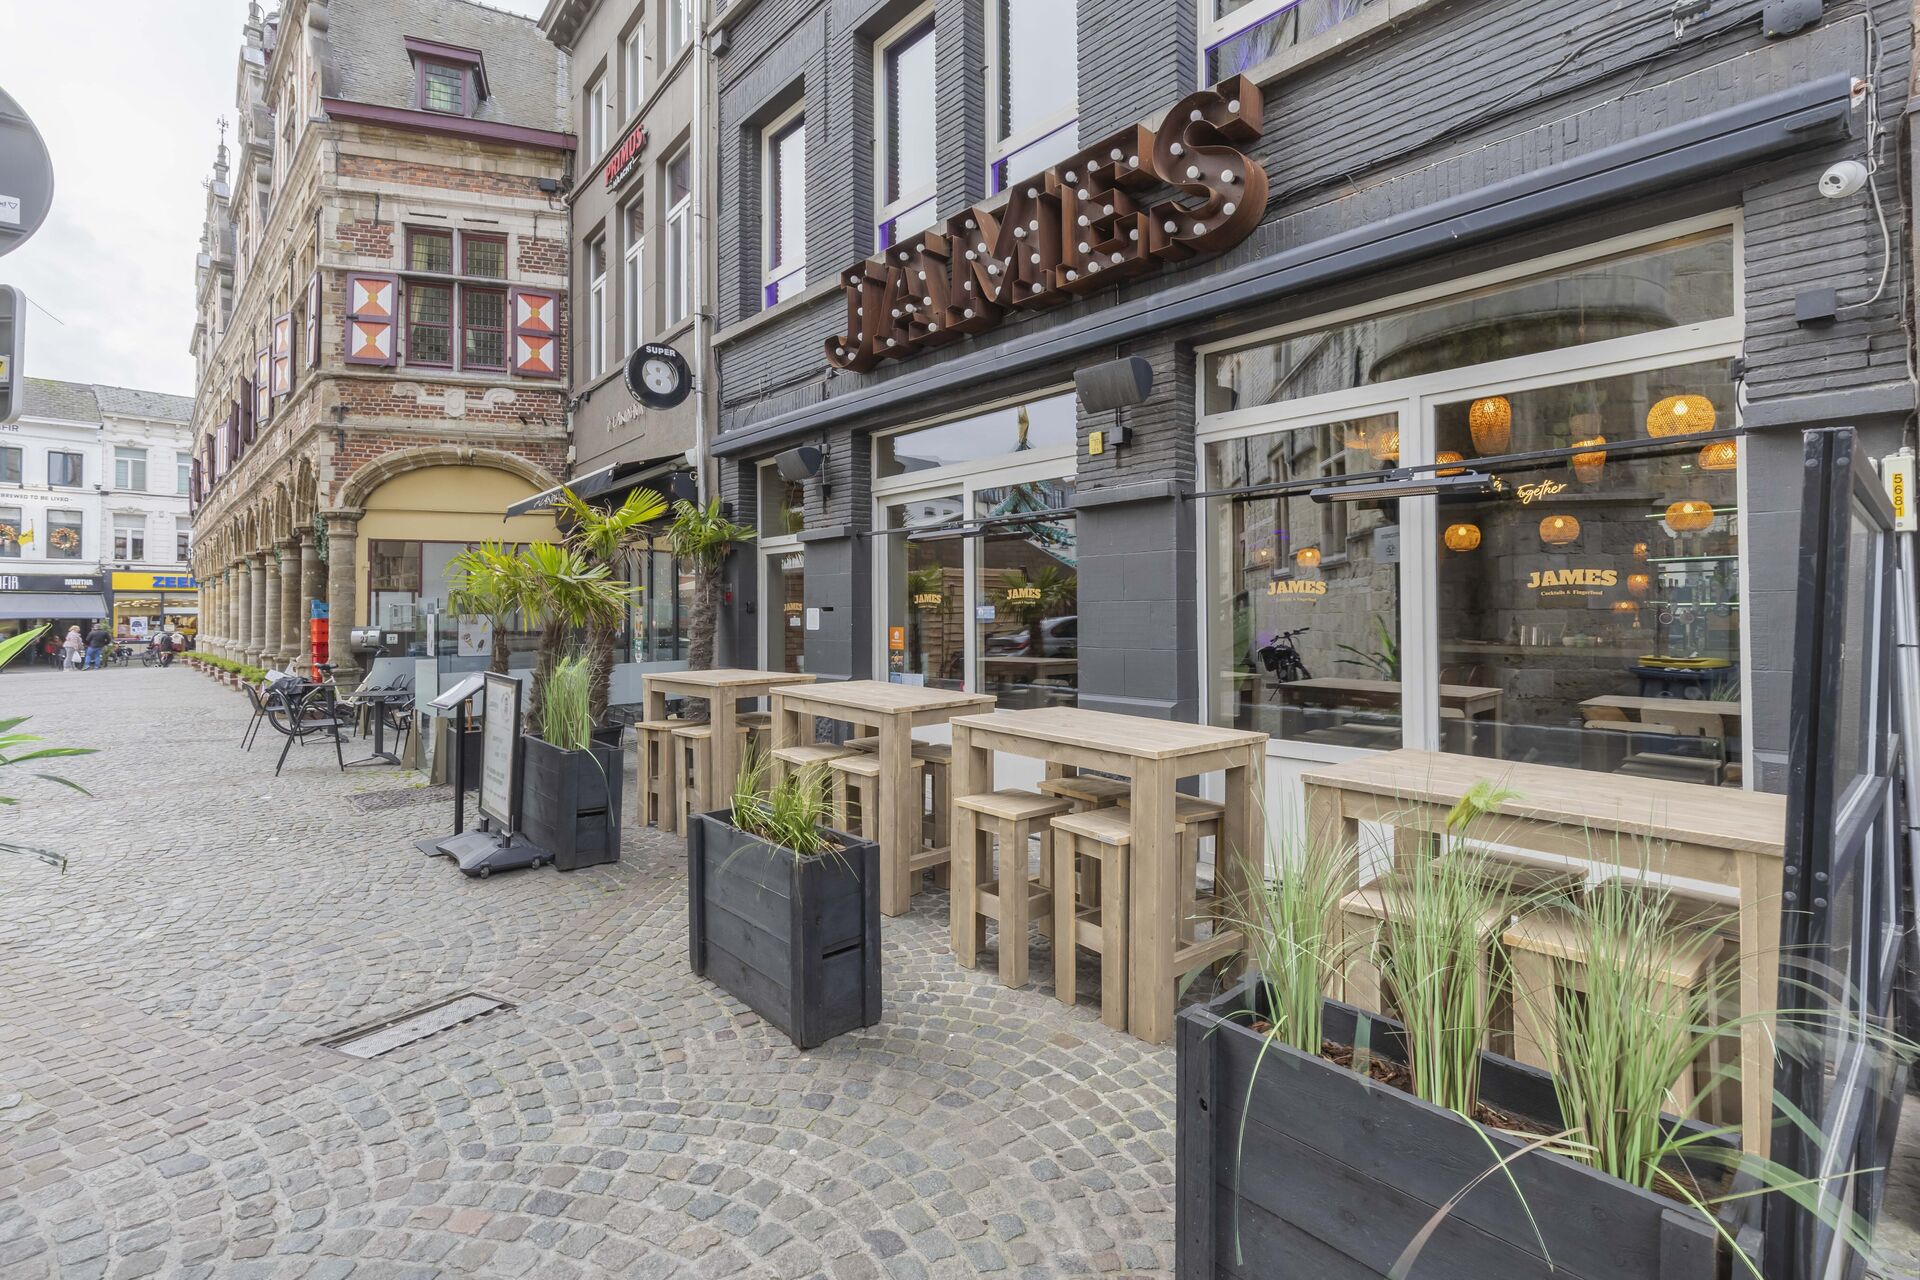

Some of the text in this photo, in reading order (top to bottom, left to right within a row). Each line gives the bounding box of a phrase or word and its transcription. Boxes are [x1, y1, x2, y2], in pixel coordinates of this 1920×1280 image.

[605, 126, 644, 187] PRIMUS
[824, 74, 1269, 374] JAMES
[646, 345, 676, 357] SUPER
[645, 359, 674, 394] 8
[1517, 479, 1567, 504] Together
[1527, 568, 1618, 588] JAMES
[1006, 587, 1042, 600] JAMES
[1267, 579, 1327, 596] JAMES
[783, 602, 803, 612] JAMES
[913, 593, 942, 604] JAMES
